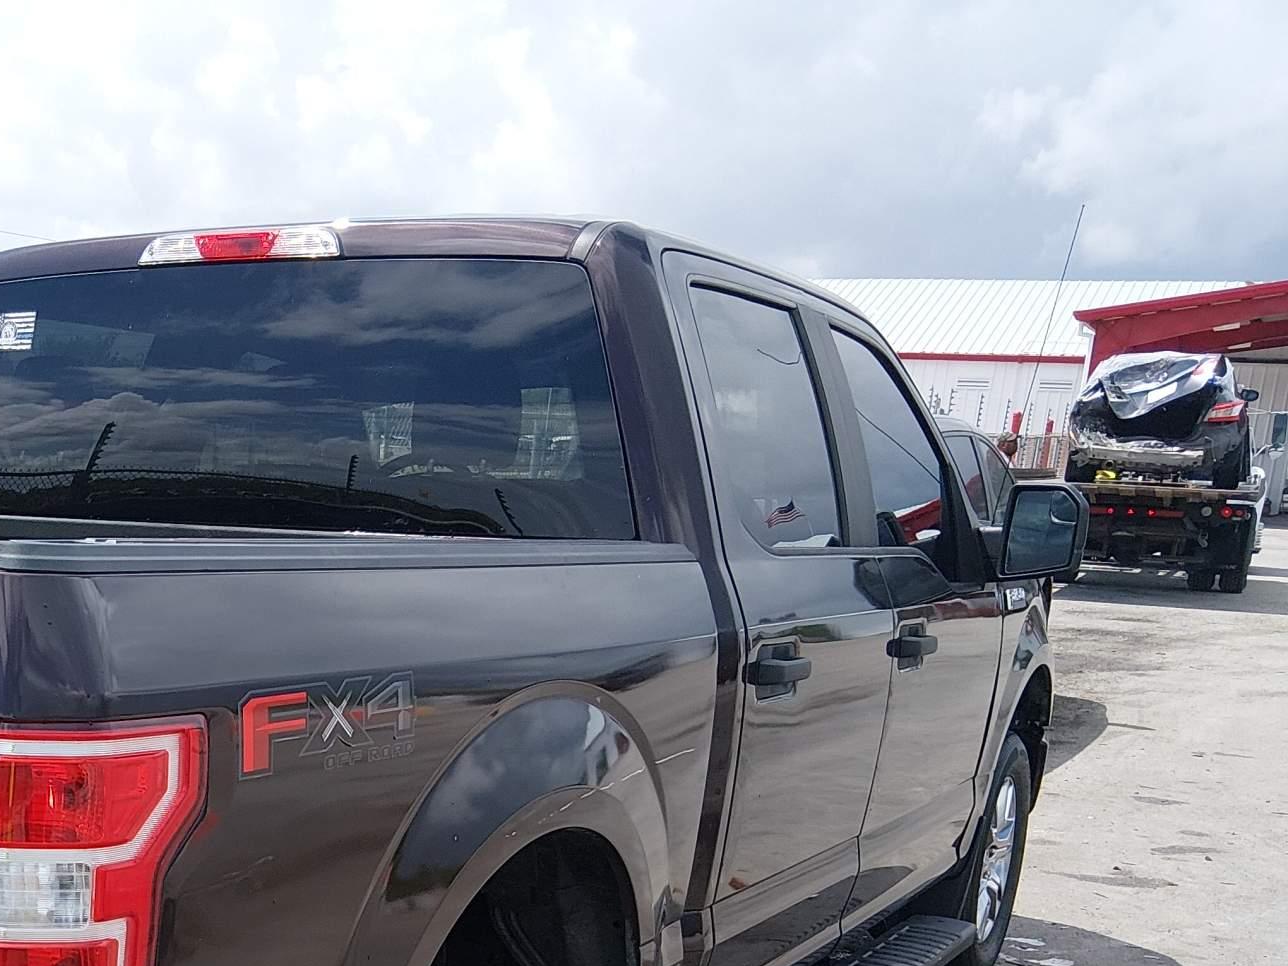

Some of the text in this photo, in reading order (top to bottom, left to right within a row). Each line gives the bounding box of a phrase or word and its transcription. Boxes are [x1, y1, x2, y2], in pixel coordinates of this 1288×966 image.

[240, 672, 415, 779] FX4
[323, 742, 414, 769] OFF ROAD
